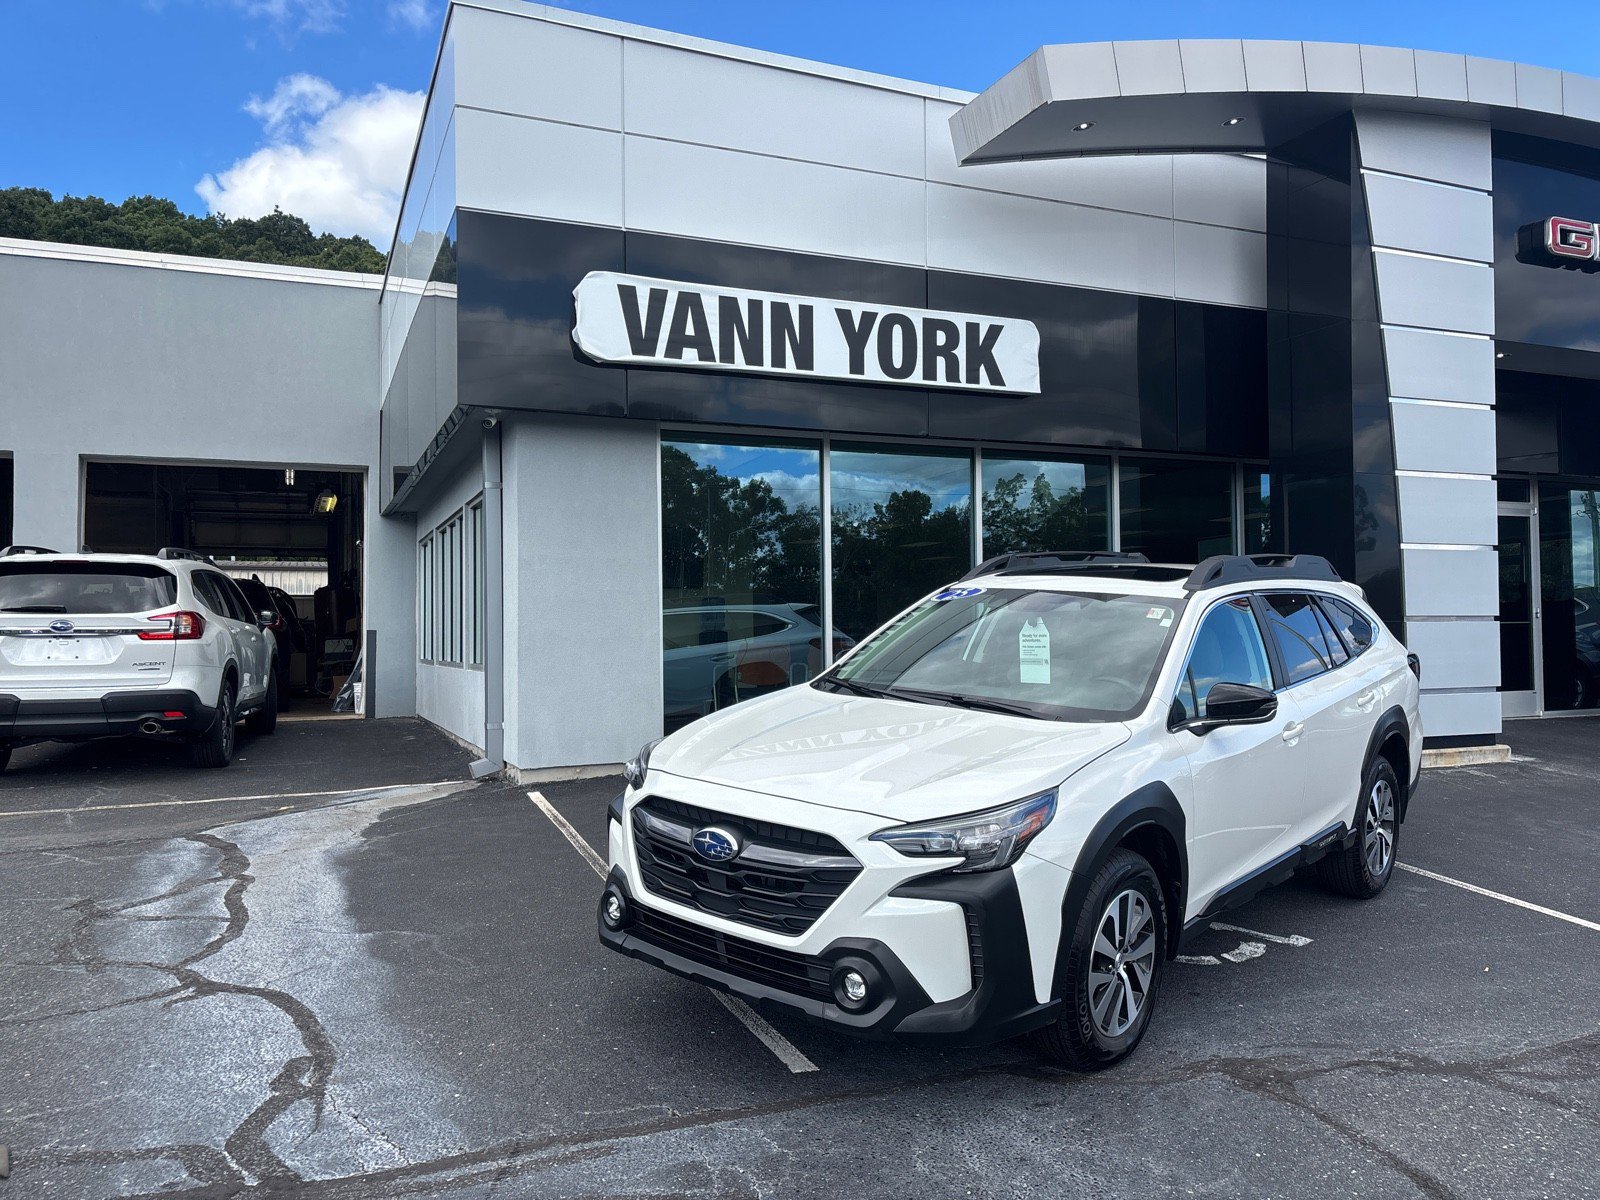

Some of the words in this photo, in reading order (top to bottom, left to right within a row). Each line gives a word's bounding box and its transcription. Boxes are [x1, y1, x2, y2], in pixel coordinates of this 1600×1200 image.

[1545, 216, 1600, 261] G
[617, 284, 814, 371] VANN
[834, 307, 1006, 387] YORK
